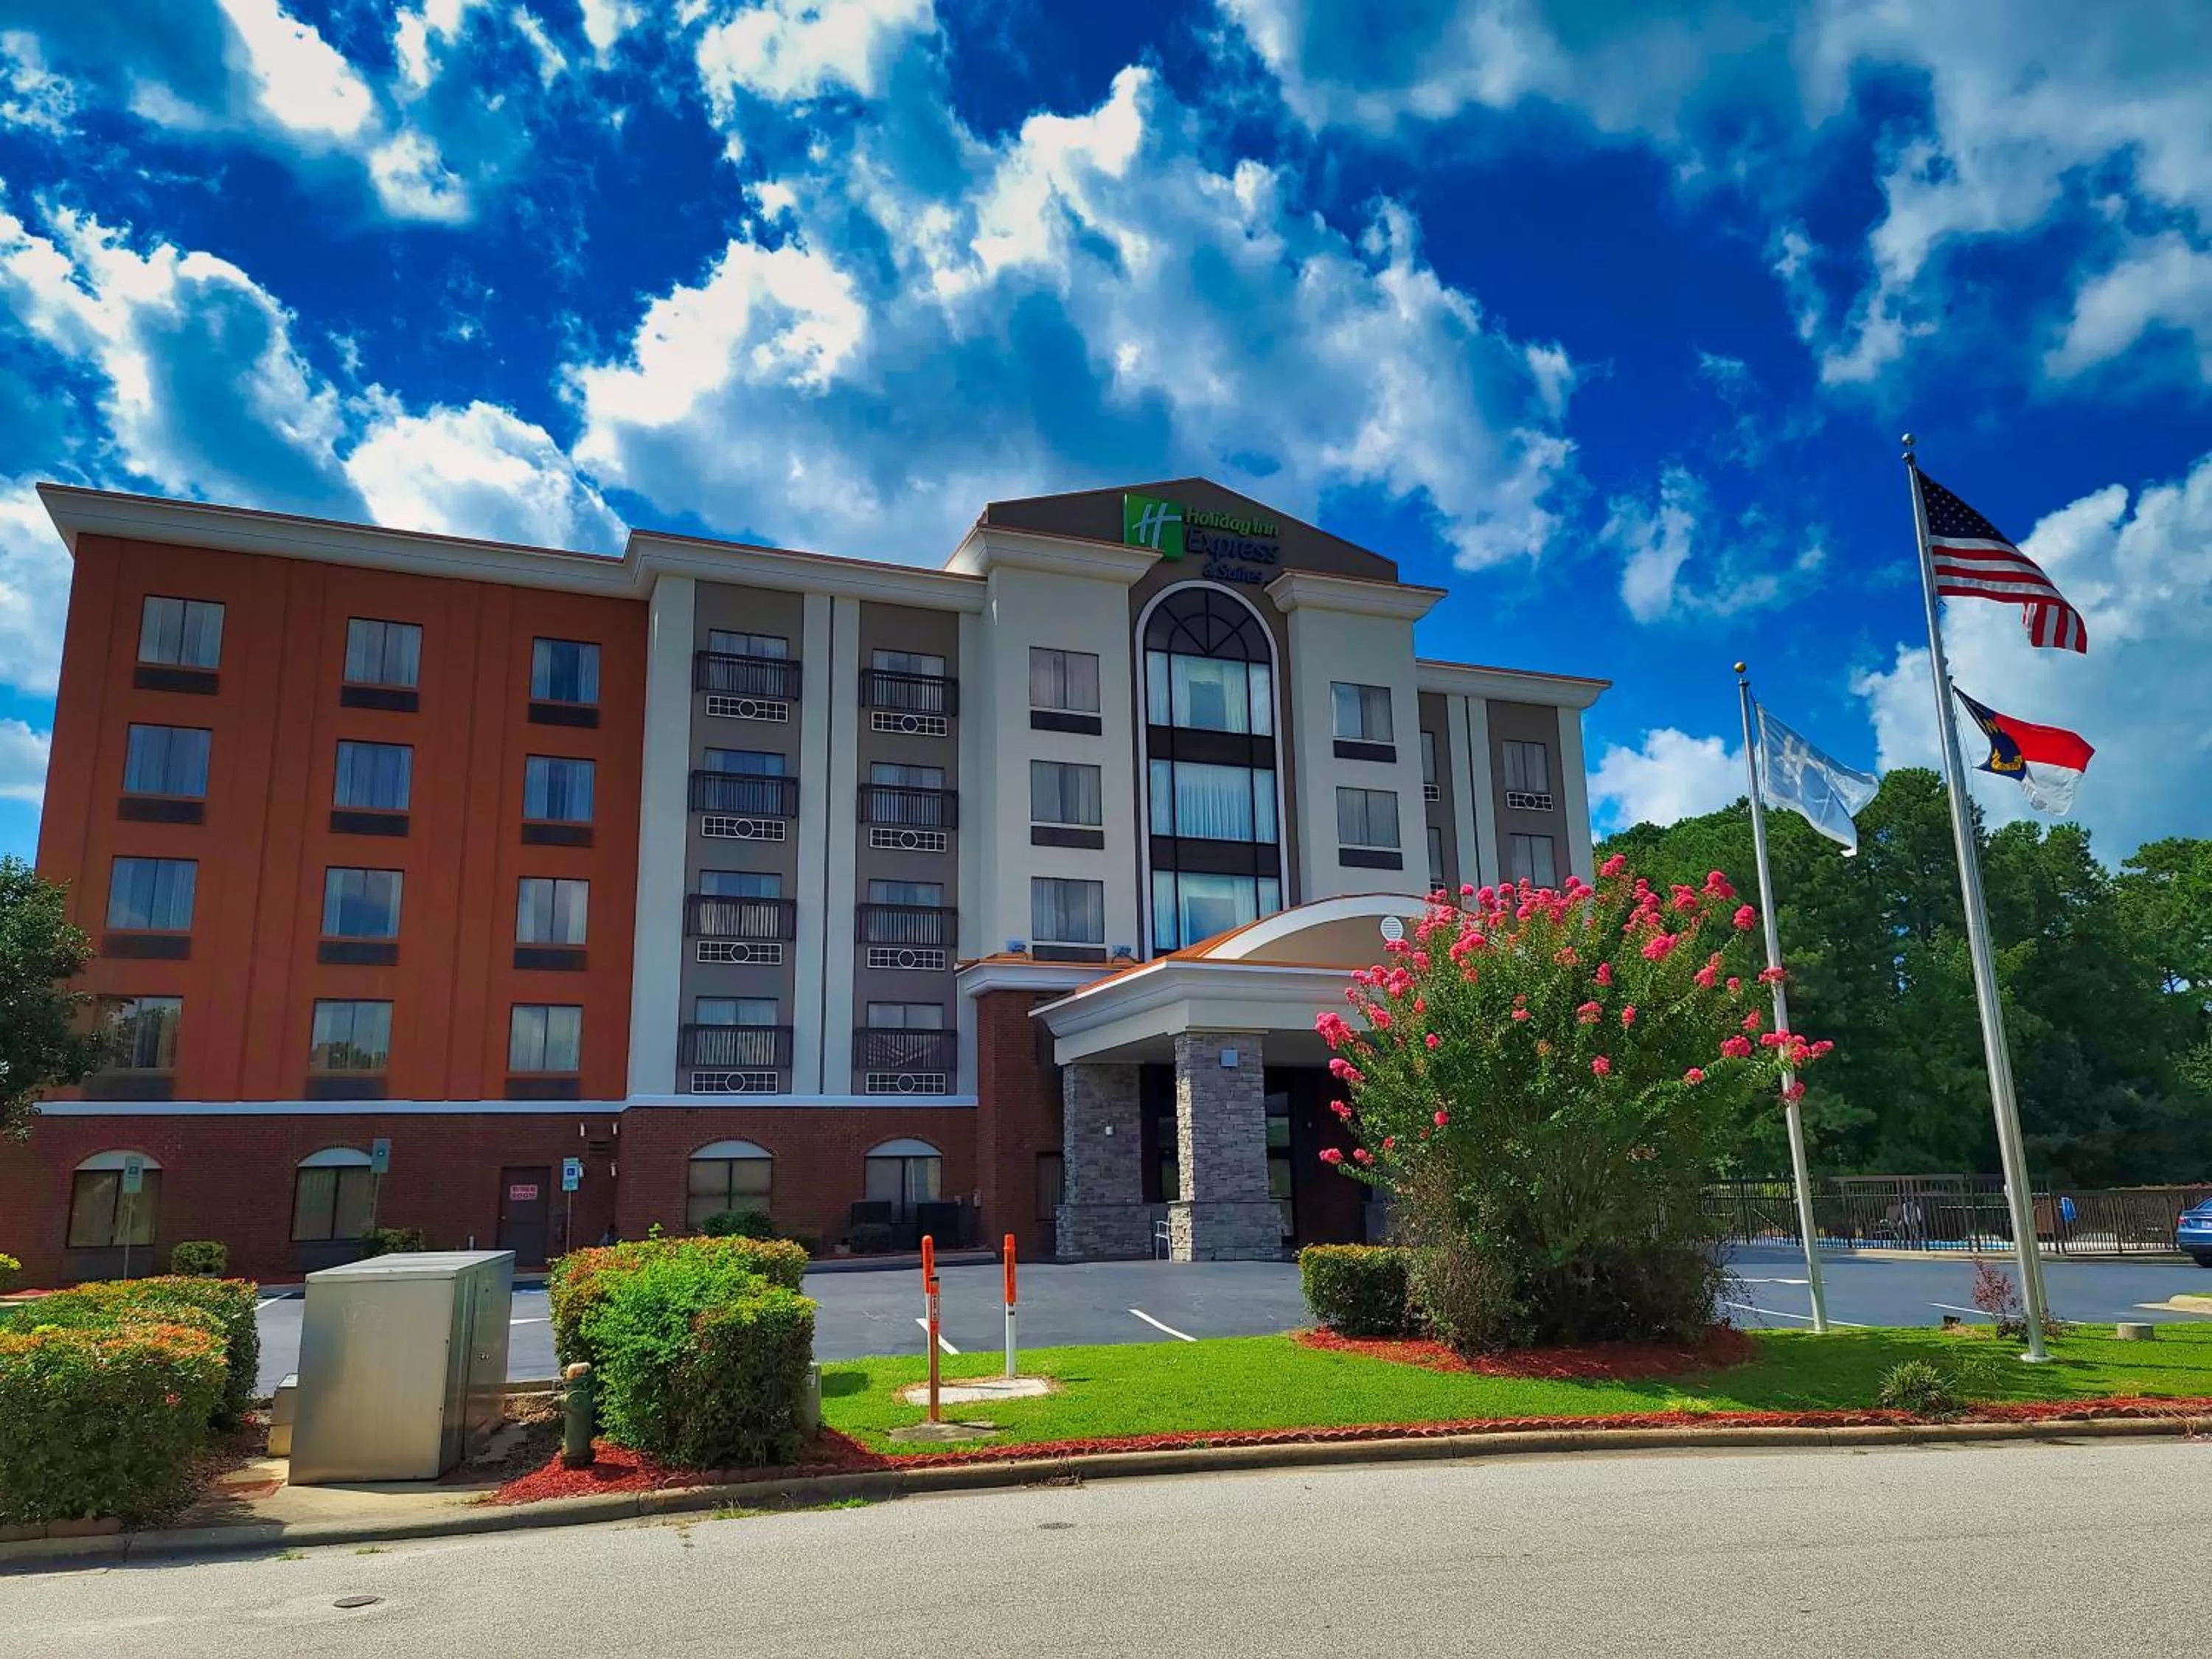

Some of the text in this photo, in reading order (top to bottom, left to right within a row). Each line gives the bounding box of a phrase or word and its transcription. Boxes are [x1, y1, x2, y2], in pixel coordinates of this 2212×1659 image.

[1186, 507, 1279, 536] Holiday Inn
[1188, 527, 1280, 563] Express
[1217, 564, 1262, 583] Suites
